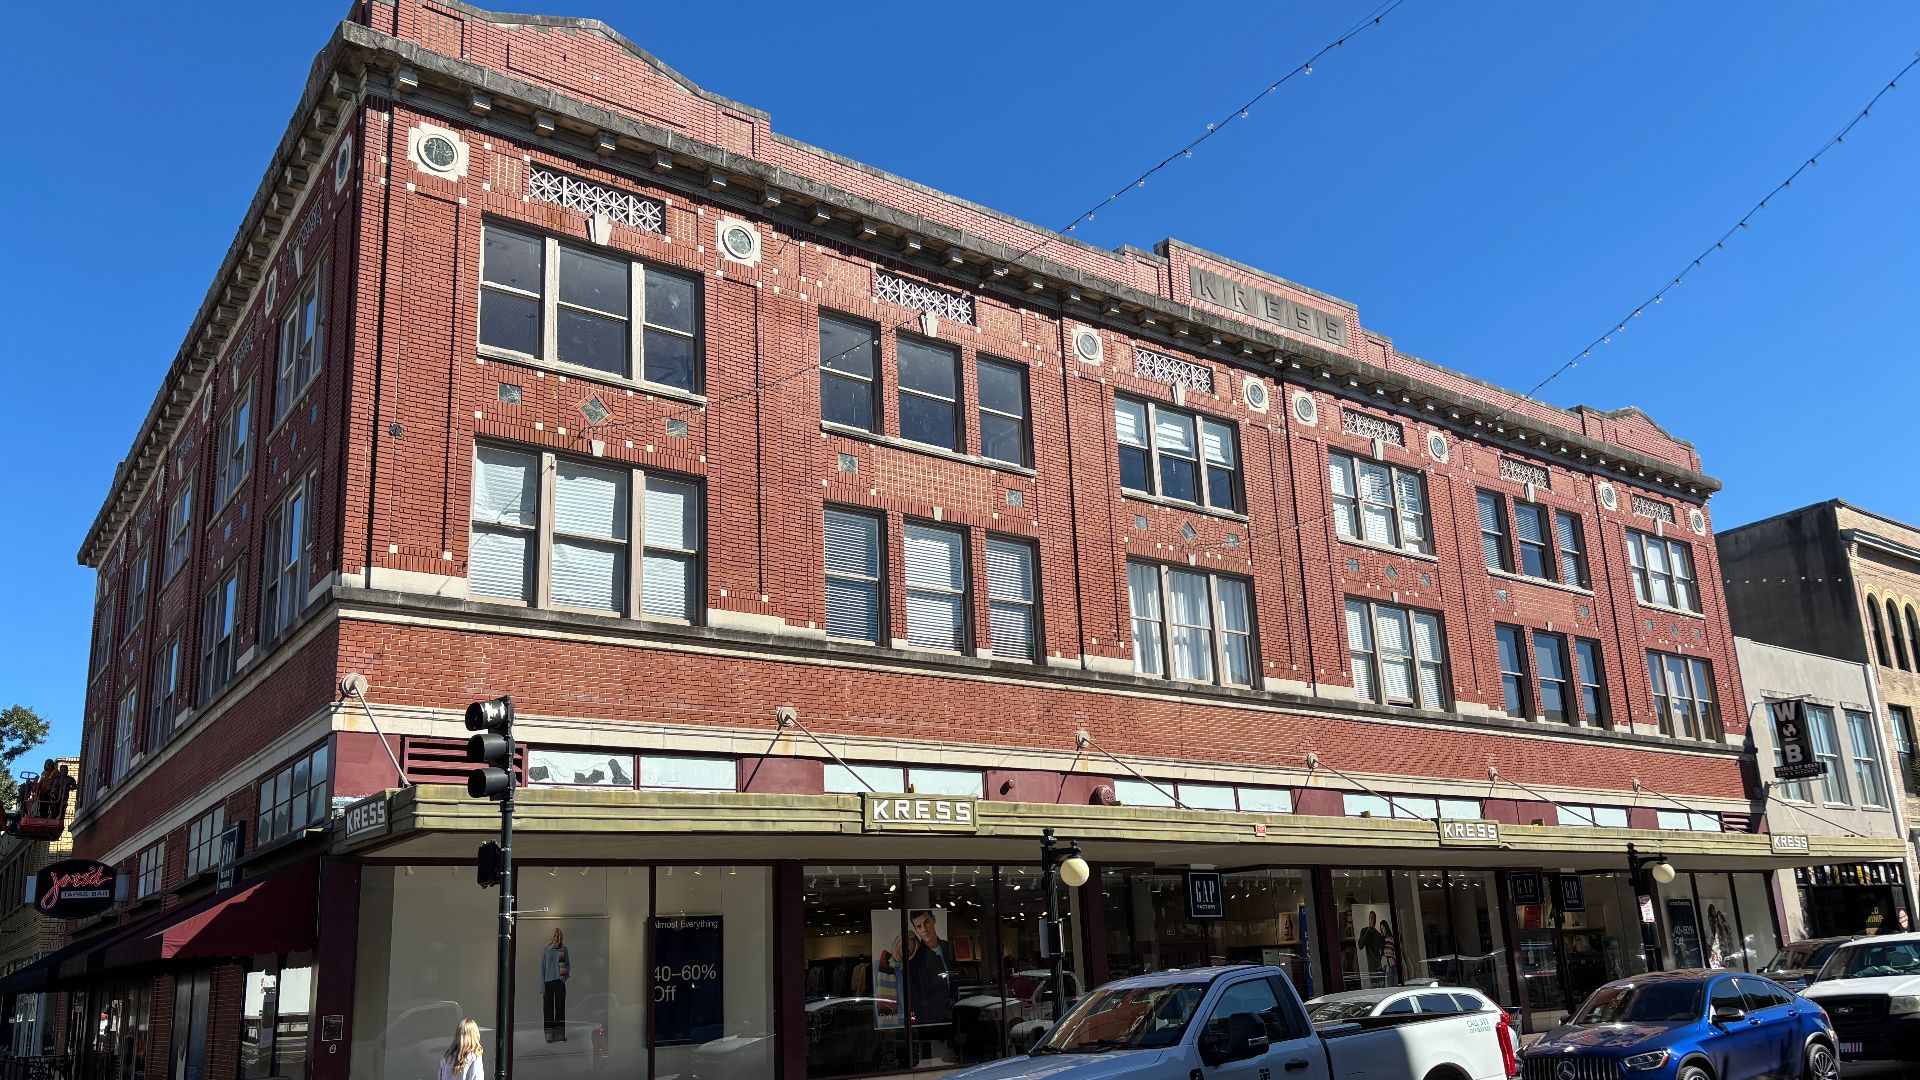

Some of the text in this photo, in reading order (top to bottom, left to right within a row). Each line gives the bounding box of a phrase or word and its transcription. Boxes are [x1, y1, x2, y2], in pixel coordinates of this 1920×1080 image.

[1199, 273, 1341, 342] KRESS
[346, 801, 385, 835] KRESS
[873, 800, 971, 821] KRESS
[1443, 823, 1497, 839] KRESS
[1773, 836, 1807, 848] KRESS
[1195, 880, 1215, 903] GAP
[681, 919, 718, 930] Everything
